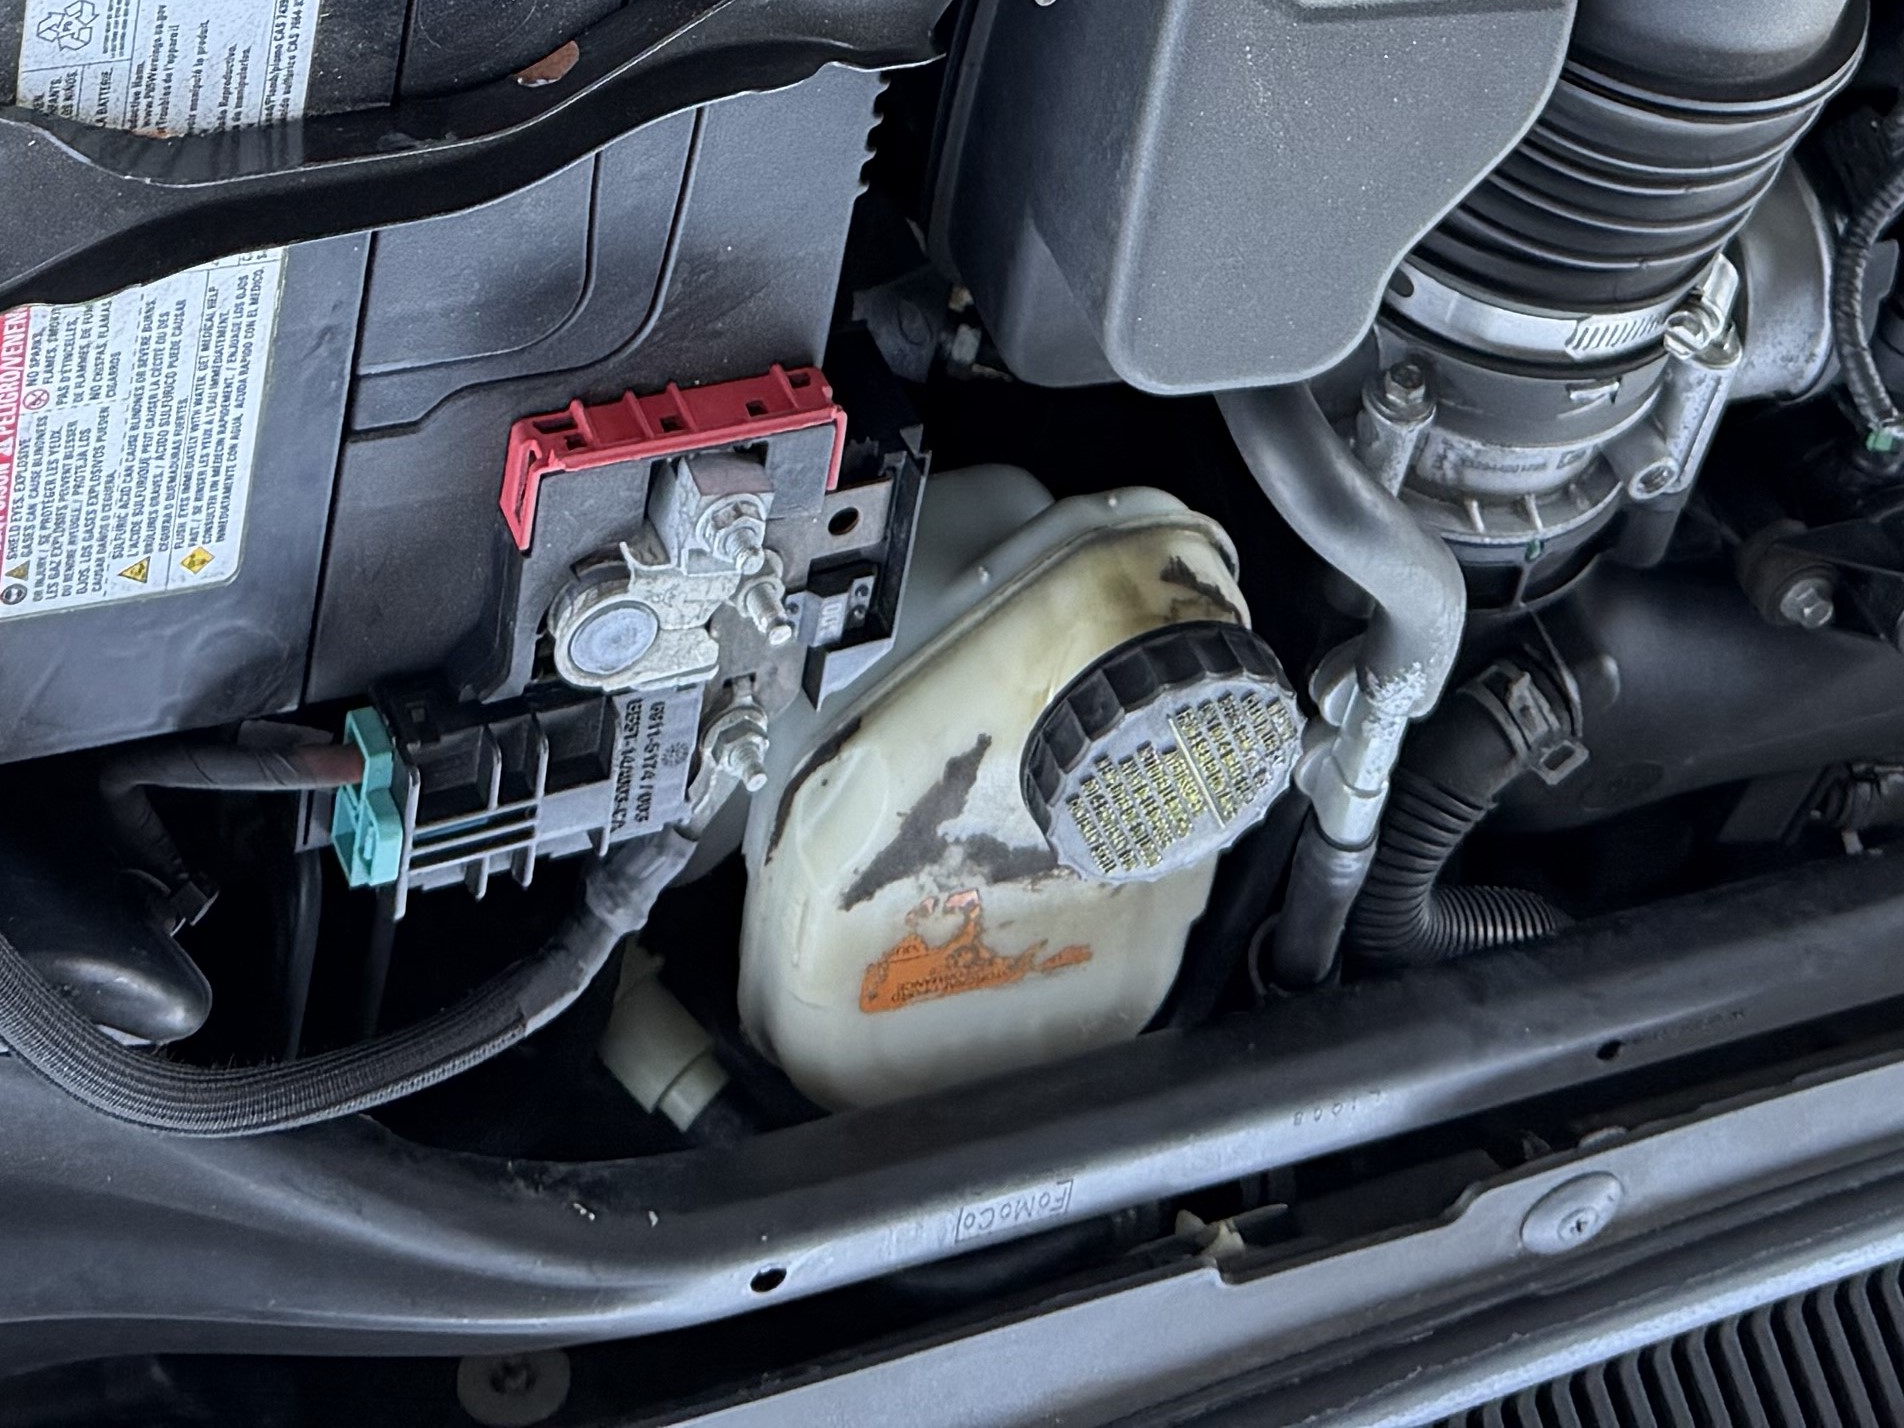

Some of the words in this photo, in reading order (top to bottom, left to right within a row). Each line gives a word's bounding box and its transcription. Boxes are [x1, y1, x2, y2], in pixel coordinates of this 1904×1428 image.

[273, 21, 286, 41] CAS
[287, 32, 300, 52] CAS
[95, 66, 113, 114] BATTERIE.
[231, 301, 244, 319] LOS
[242, 319, 256, 339] CON
[147, 378, 161, 391] LA
[155, 310, 170, 329] DES
[197, 354, 209, 371] GET
[25, 370, 39, 387] NO
[54, 384, 70, 405] PAS
[71, 390, 85, 403] DE
[88, 384, 102, 400] NO
[30, 414, 49, 467] BLINDNESS
[77, 427, 93, 448] LOS
[45, 457, 60, 476] LES
[197, 452, 210, 468] LES
[71, 449, 90, 496] PROTEJA
[86, 444, 106, 506] EXPLOSIVOS
[121, 464, 134, 483] CAN
[26, 468, 42, 499] CAUSE
[4, 524, 21, 560] SHIELD
[13, 437, 32, 492] EXPLOSIVE
[118, 485, 132, 509] ACID
[23, 502, 38, 522] CAN
[82, 508, 98, 542] GASES
[112, 511, 128, 559] SULFURIC
[18, 523, 35, 558] GASES
[79, 543, 93, 563] LOS
[47, 559, 62, 579] GAZ
[44, 581, 59, 599] LES
[960, 1186, 1071, 1234] FoMoCo
